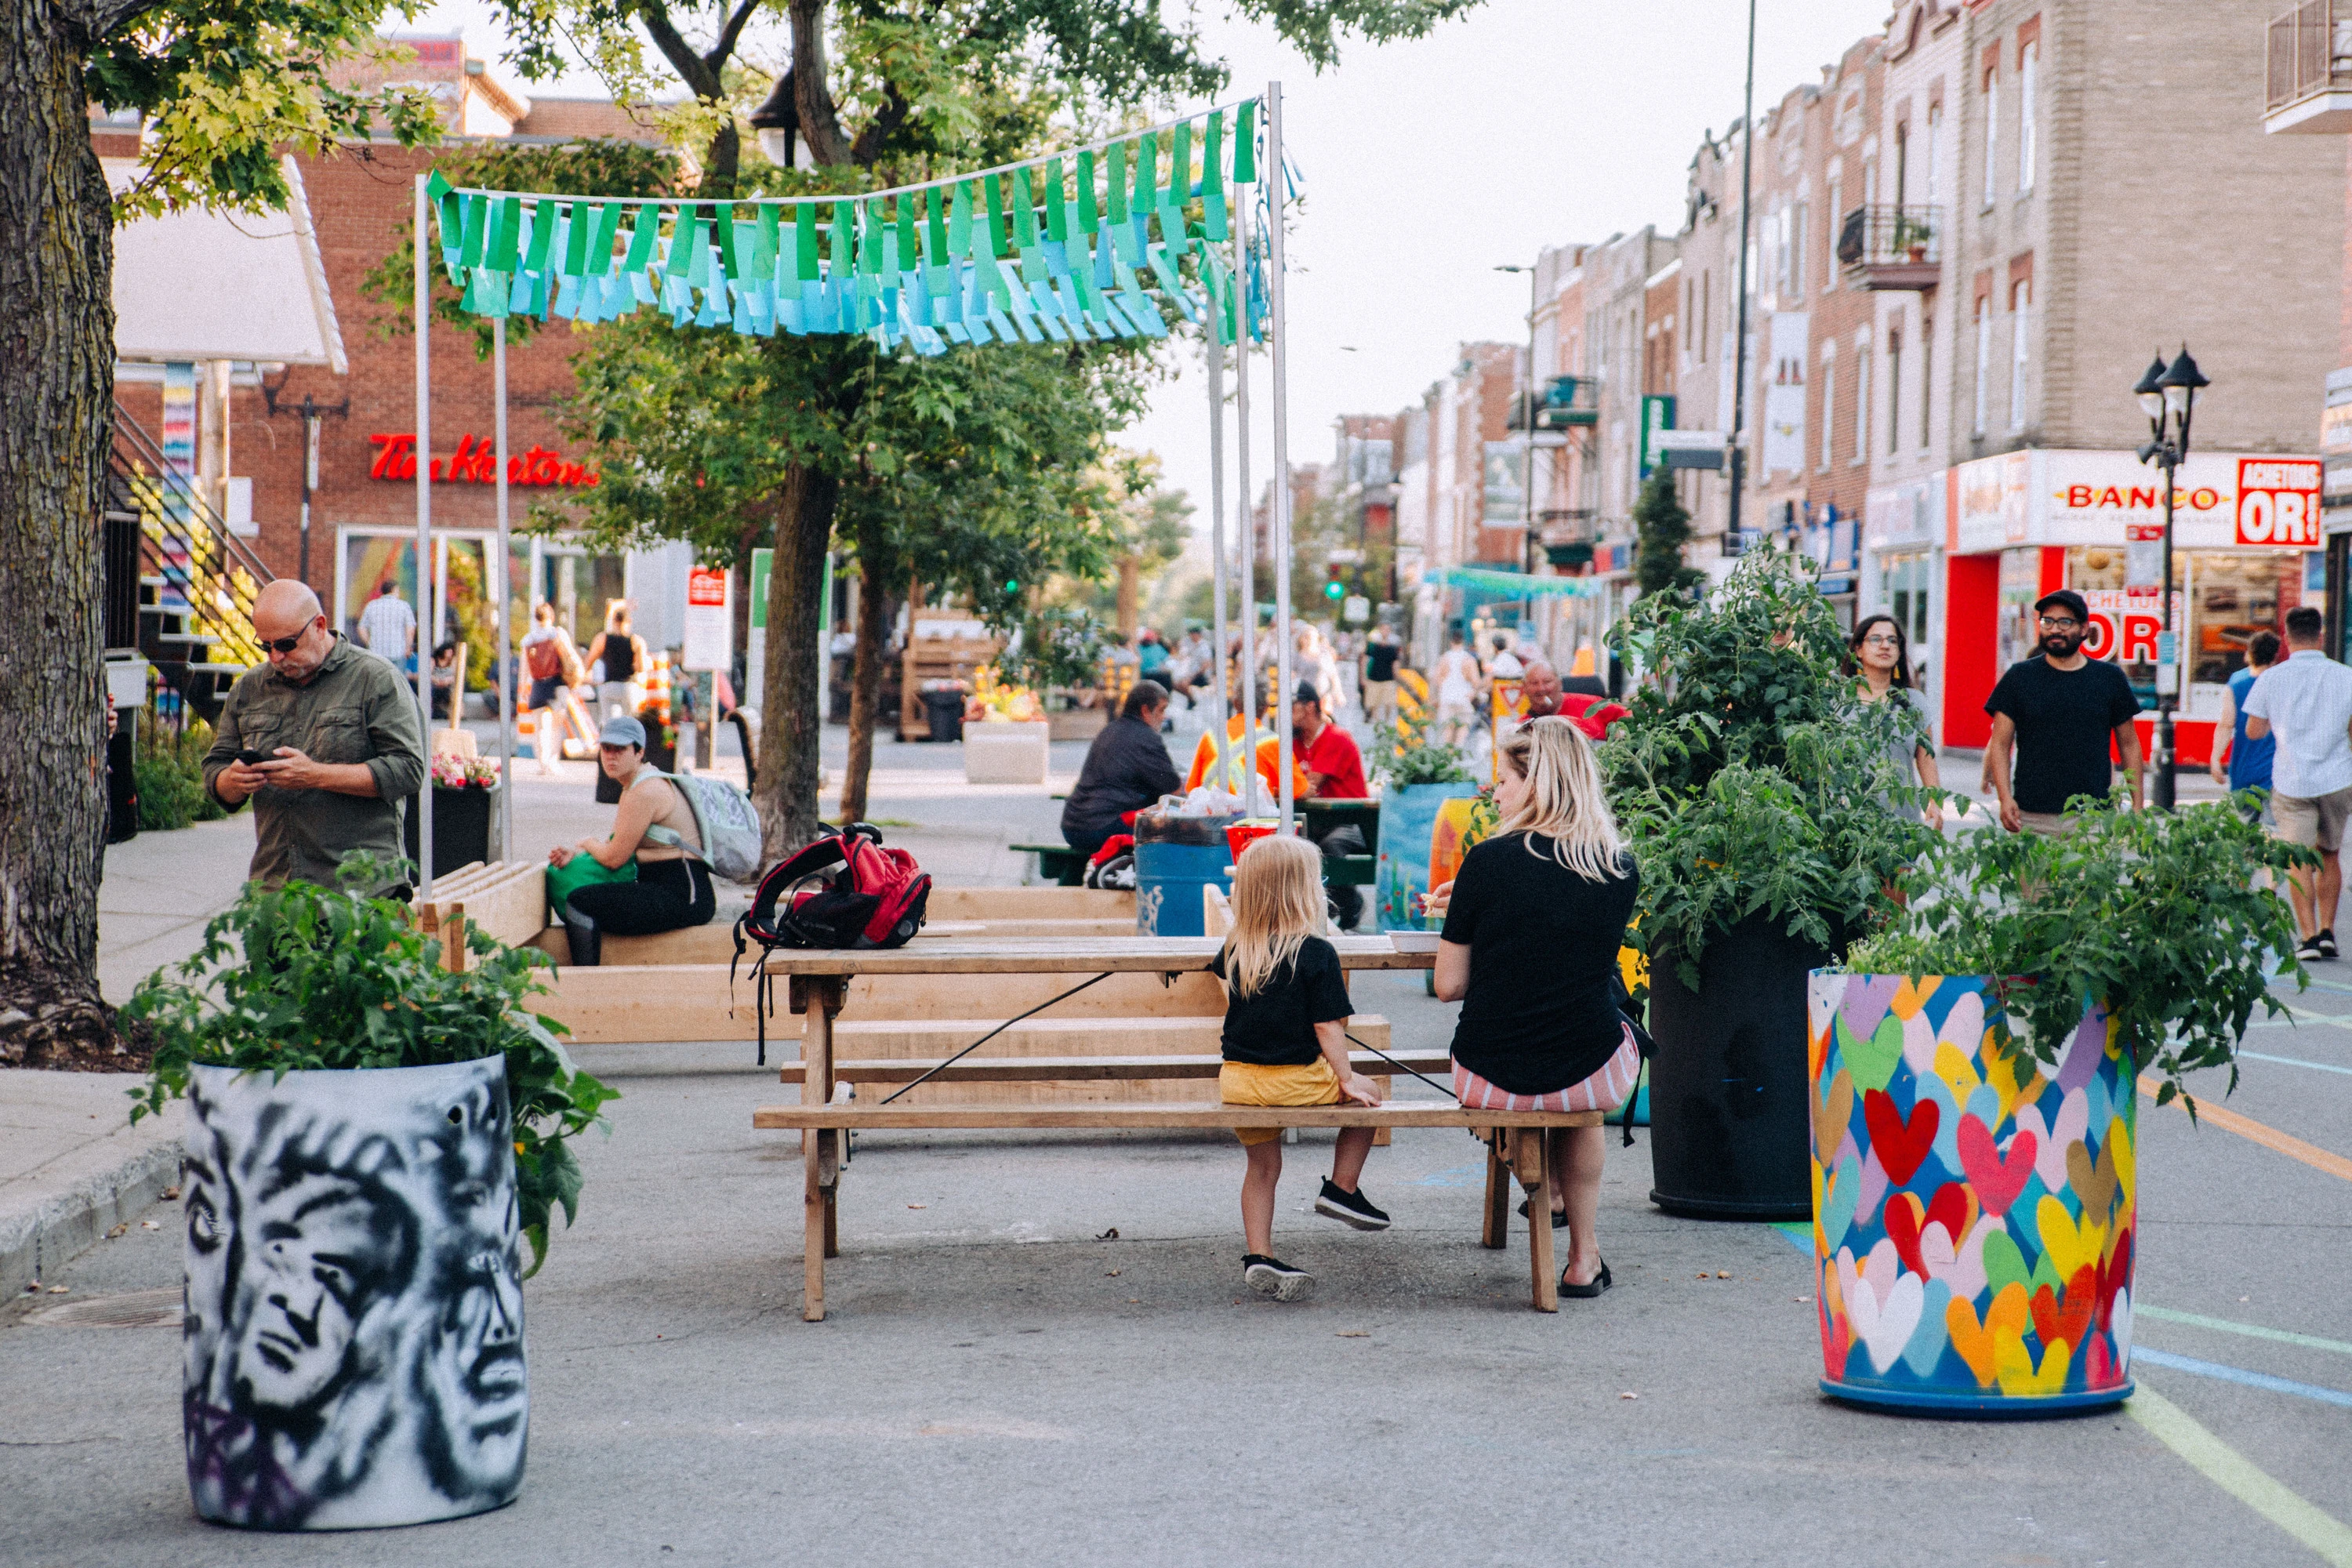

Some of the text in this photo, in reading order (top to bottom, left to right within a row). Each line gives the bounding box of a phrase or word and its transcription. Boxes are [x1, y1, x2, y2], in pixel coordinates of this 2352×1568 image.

[370, 434, 442, 482] Tim
[2242, 462, 2321, 491] ACHETONS
[2067, 484, 2219, 510] BANCO
[2085, 591, 2181, 610] CHETONS
